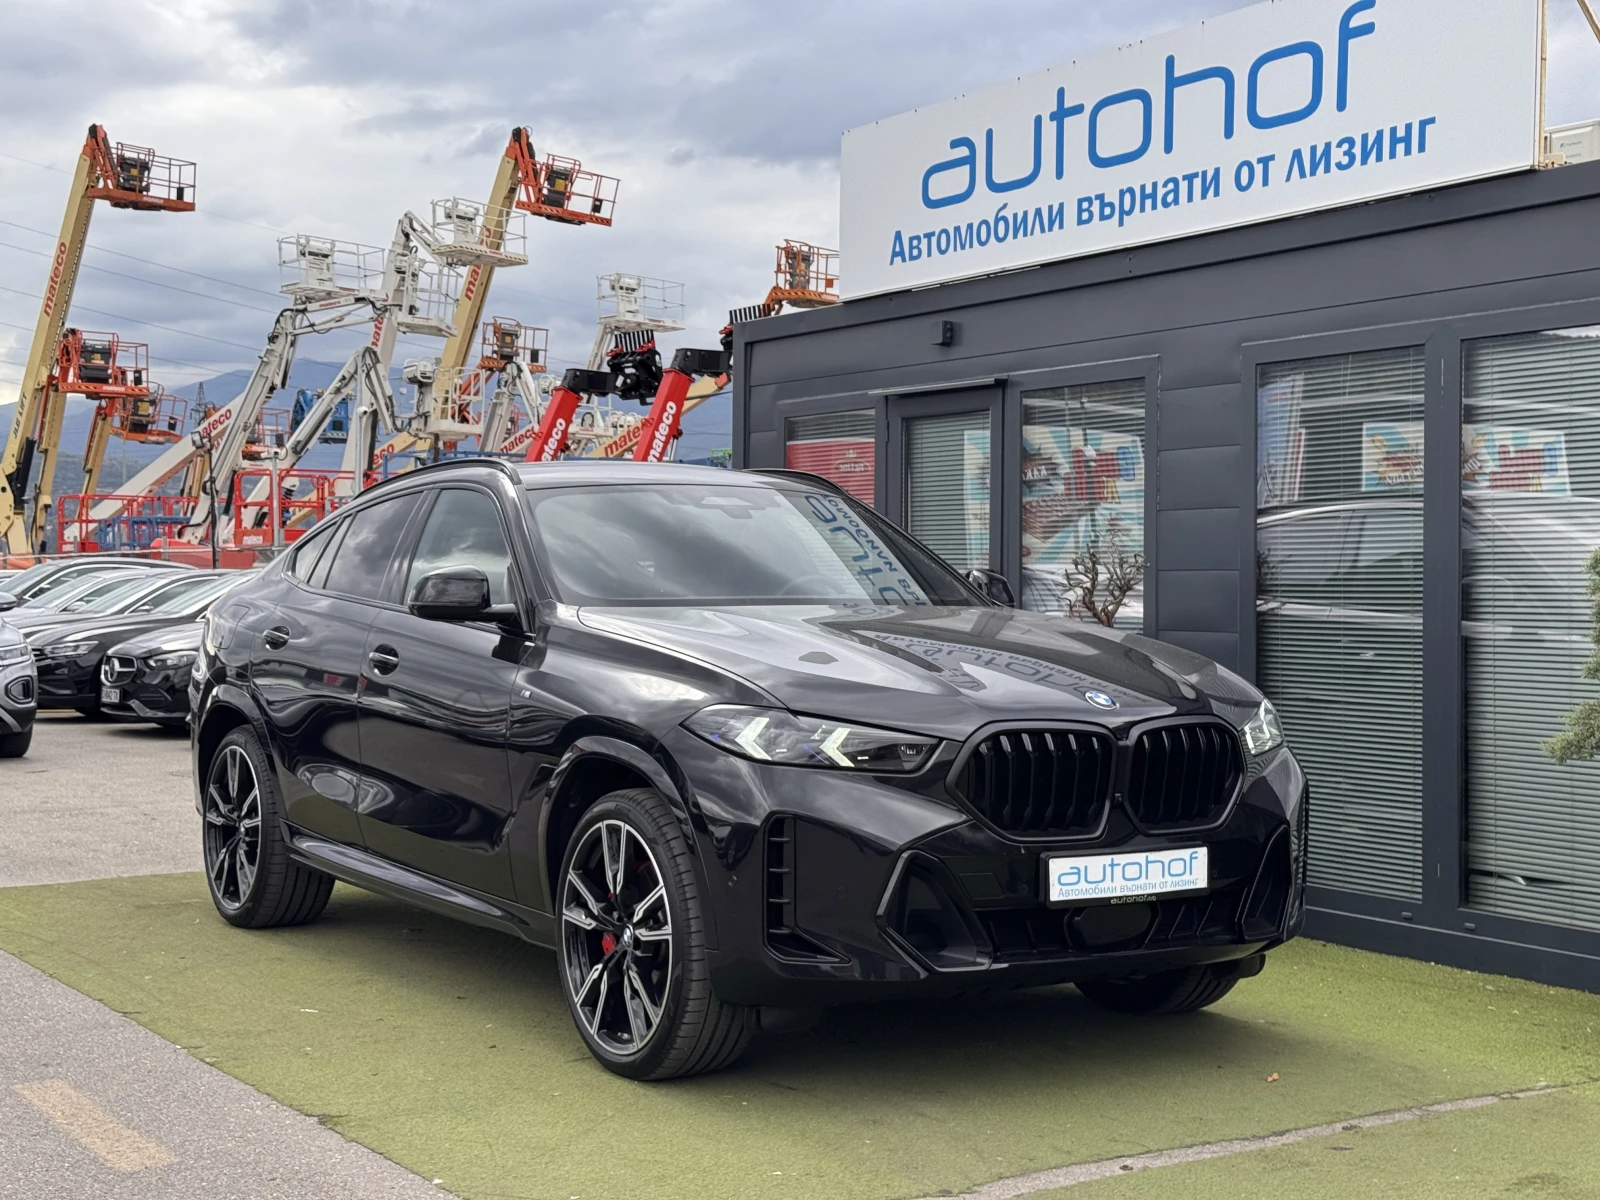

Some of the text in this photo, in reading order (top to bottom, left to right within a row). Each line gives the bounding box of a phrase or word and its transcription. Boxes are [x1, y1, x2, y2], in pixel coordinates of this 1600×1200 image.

[922, 0, 1376, 209] autohof
[889, 116, 1437, 265] Автомобили върнати от лизинг
[43, 241, 67, 318] mateco
[197, 408, 232, 440] ateco
[500, 427, 534, 453] matec
[541, 418, 566, 462] ateco
[604, 425, 641, 457] mate
[1057, 850, 1199, 887] autohof
[1057, 878, 1199, 898] Автомобили върнати от лизинг
